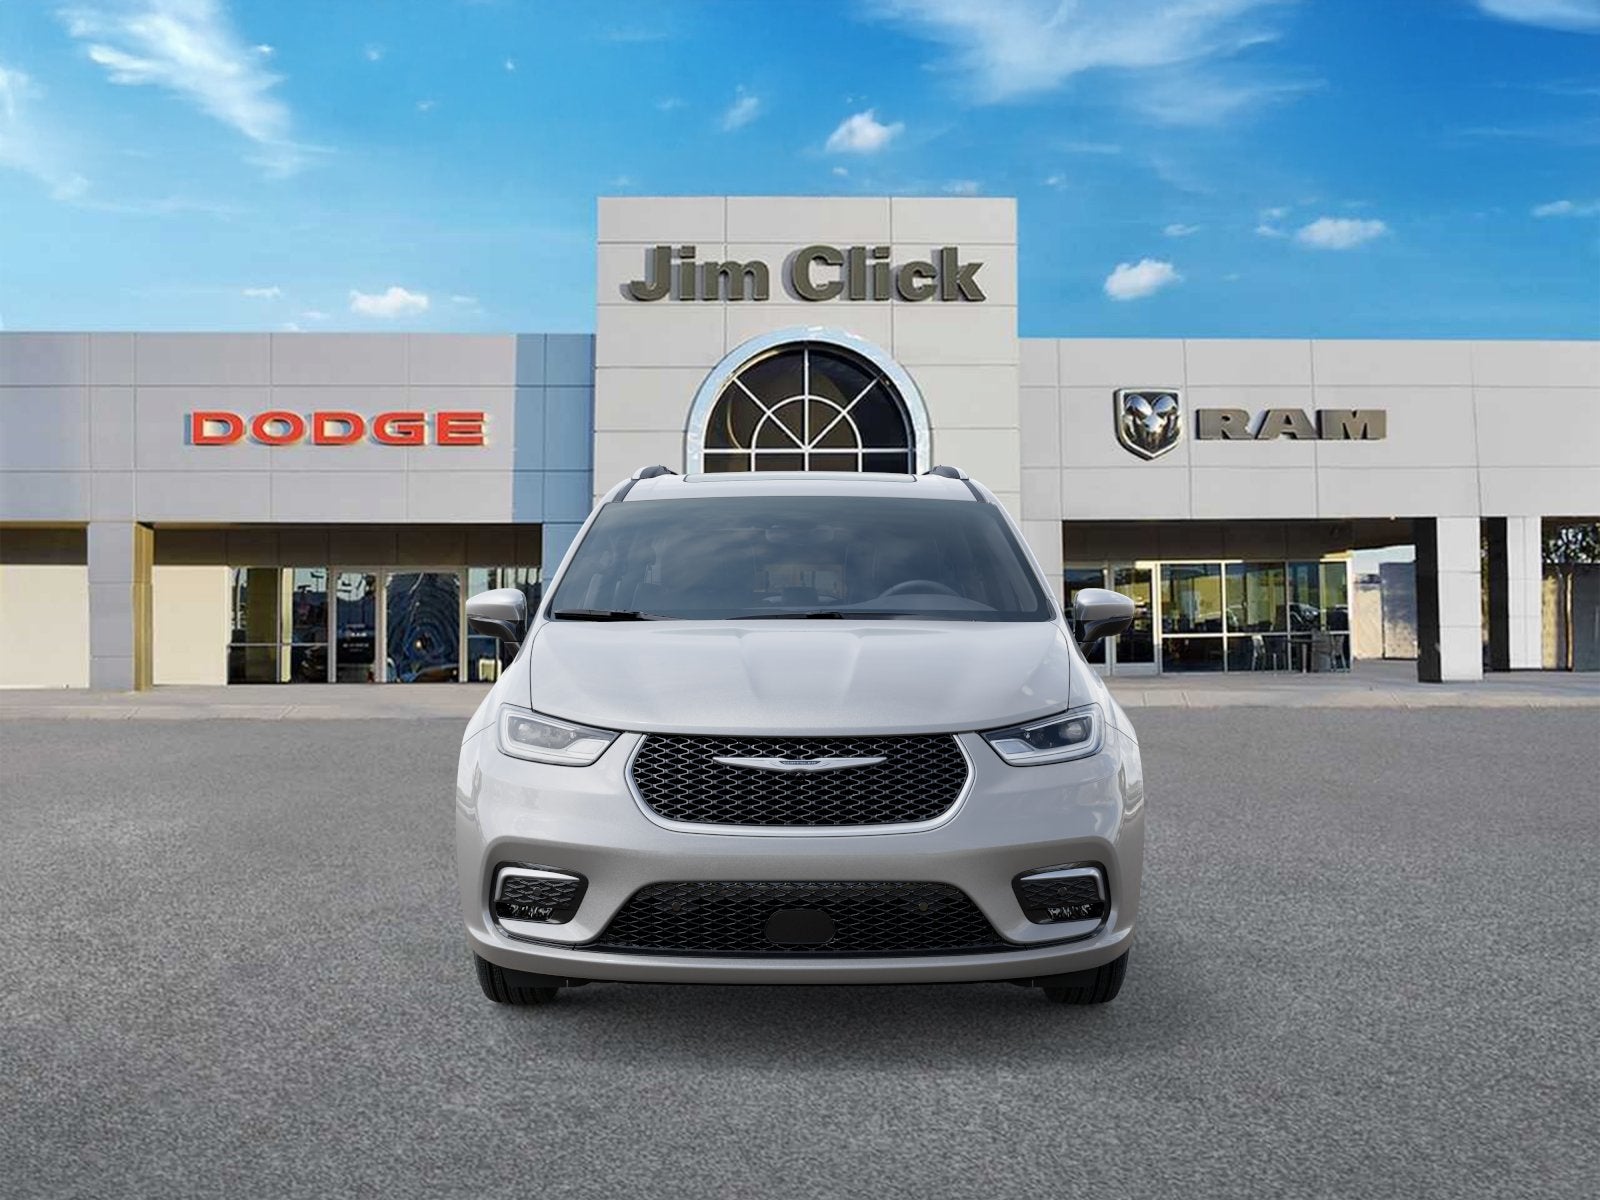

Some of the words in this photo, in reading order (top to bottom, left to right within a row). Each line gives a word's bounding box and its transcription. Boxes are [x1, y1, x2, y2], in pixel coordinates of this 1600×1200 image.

[621, 245, 770, 301] Jim
[783, 245, 986, 301] Click
[186, 411, 486, 446] DODGE
[1196, 408, 1387, 440] RAM
